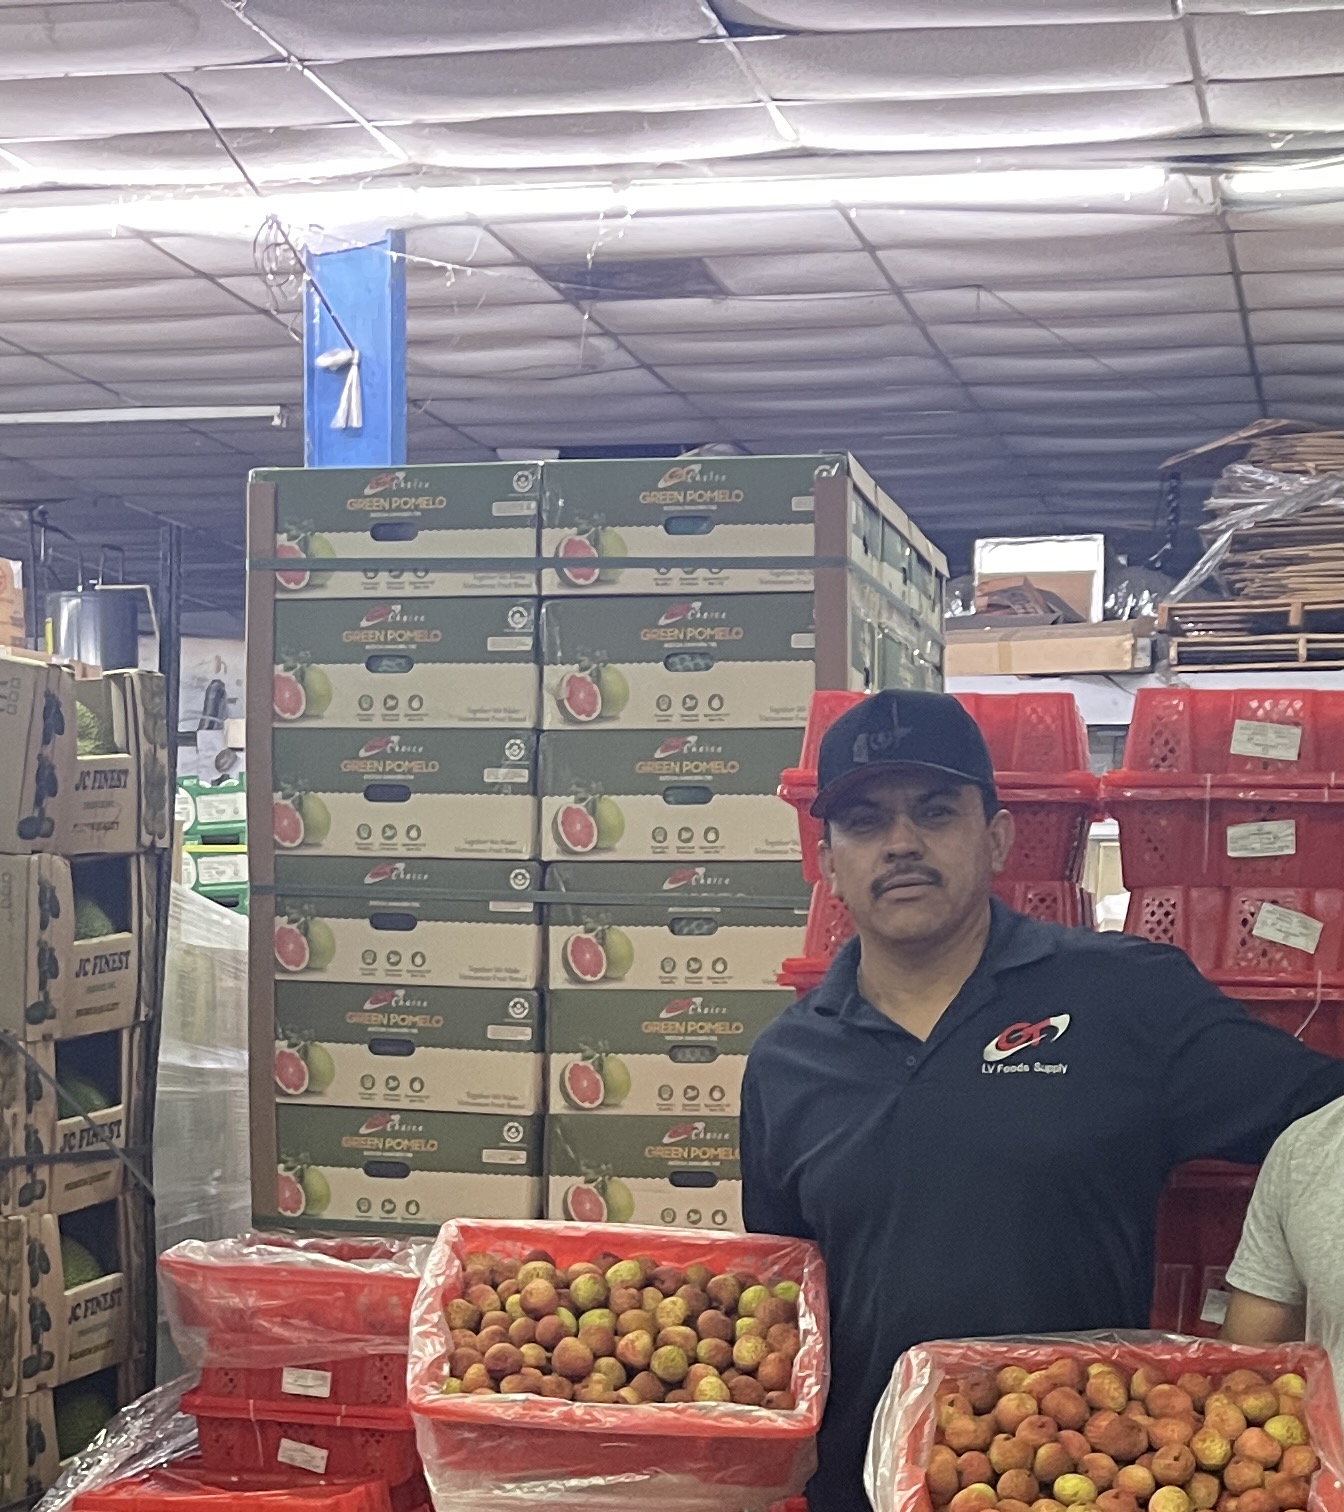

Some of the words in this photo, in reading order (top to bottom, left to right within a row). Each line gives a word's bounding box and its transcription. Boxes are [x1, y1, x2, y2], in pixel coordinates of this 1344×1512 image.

[346, 497, 390, 511] GREEN
[392, 496, 447, 511] POMELO
[639, 490, 685, 505] GREEN
[686, 489, 745, 504] POMELO
[342, 630, 386, 643] GREEN
[386, 629, 442, 643] POMELO
[640, 628, 685, 641] GREEN
[686, 627, 744, 641] POMELO
[340, 760, 384, 773] GREEN
[384, 760, 440, 773] POMELO
[634, 761, 681, 774] GREEN
[682, 760, 740, 774] POMELO
[91, 768, 130, 791] FINEST
[76, 957, 90, 979] JC
[92, 950, 131, 976] FINEST
[345, 1011, 388, 1025] GREEN
[389, 1013, 445, 1028] POMELO
[641, 1021, 686, 1034] GREEN
[687, 1021, 744, 1035] POMELO
[981, 1062, 996, 1074] LV
[997, 1062, 1030, 1074] Foods
[1033, 1061, 1069, 1075] Supply
[60, 1129, 76, 1153] JC
[341, 1136, 383, 1150] GREEN
[384, 1137, 439, 1152] POMELO
[644, 1146, 689, 1160] GREEN
[83, 1288, 123, 1319] FINEST
